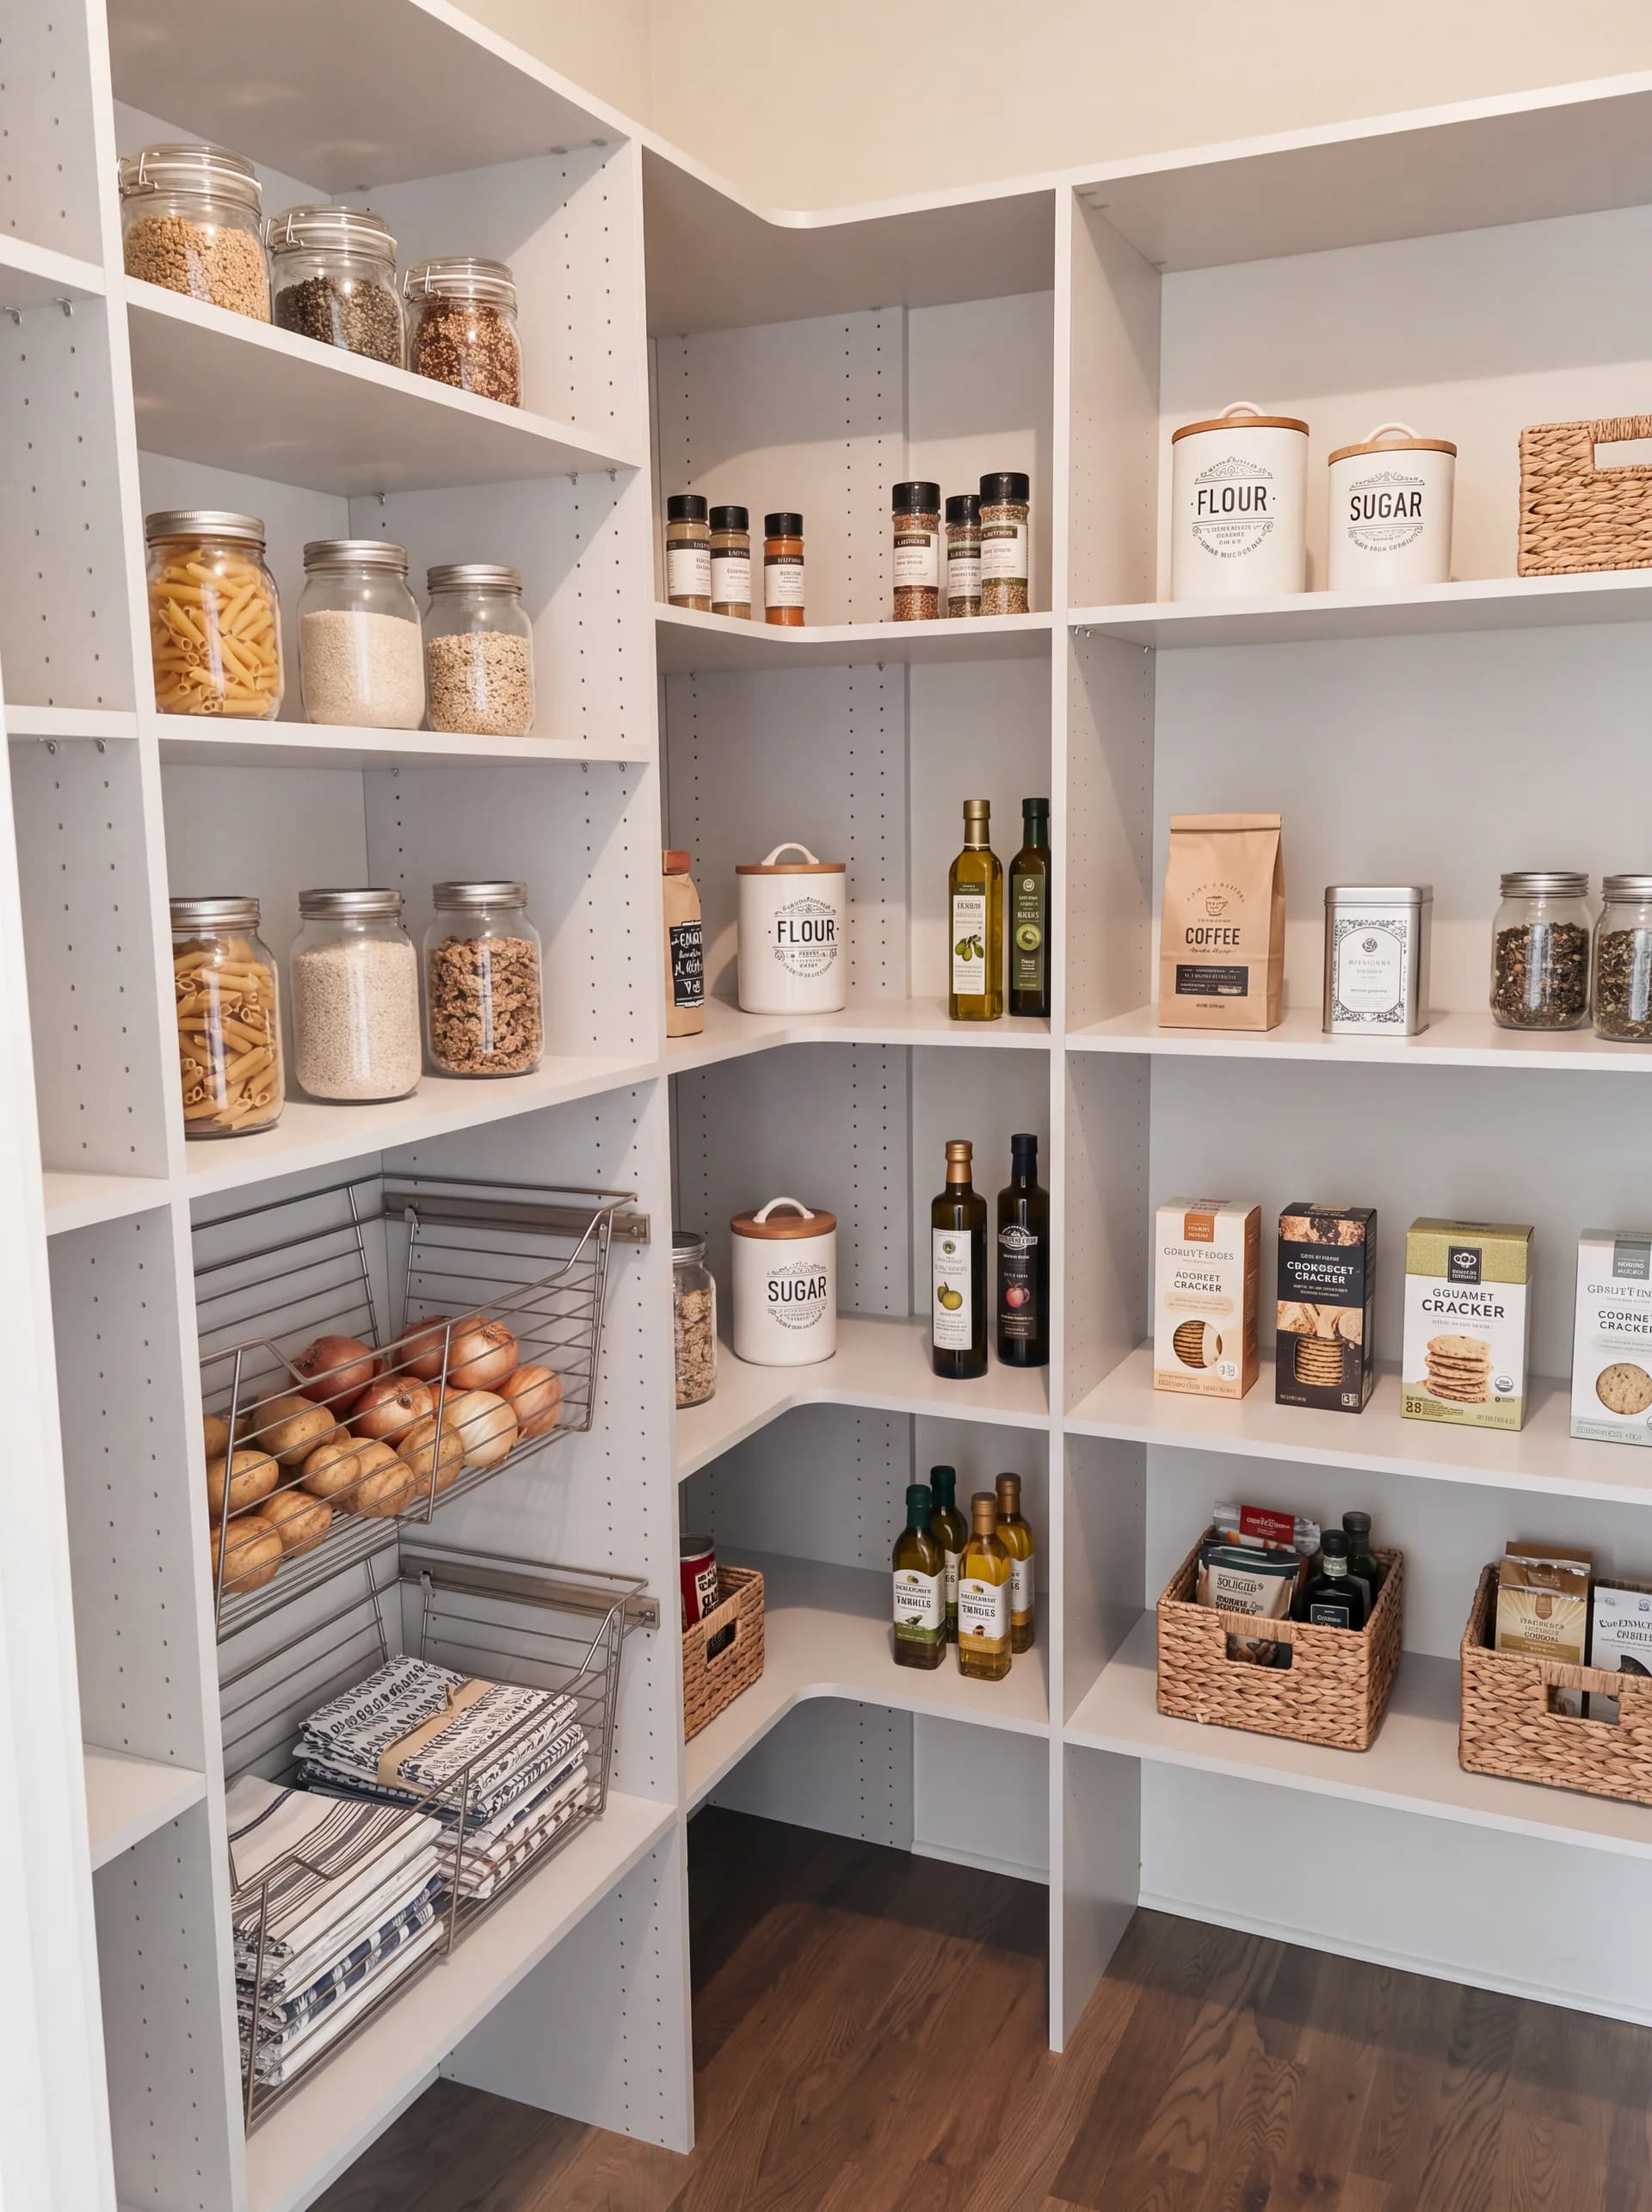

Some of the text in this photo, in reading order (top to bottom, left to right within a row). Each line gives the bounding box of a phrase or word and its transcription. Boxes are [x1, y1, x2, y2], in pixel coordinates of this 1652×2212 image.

[1197, 485, 1268, 516] FLOUR
[1350, 491, 1423, 521] SUGAR
[778, 919, 835, 943] FLOUR
[1185, 927, 1241, 945] COFFEE
[1174, 1280, 1222, 1292] CRACKER
[1295, 1272, 1346, 1285] CRACKER
[767, 1276, 827, 1303] SUGAR
[1421, 1298, 1505, 1318] CRACKER
[1598, 1310, 1652, 1323] COORNE
